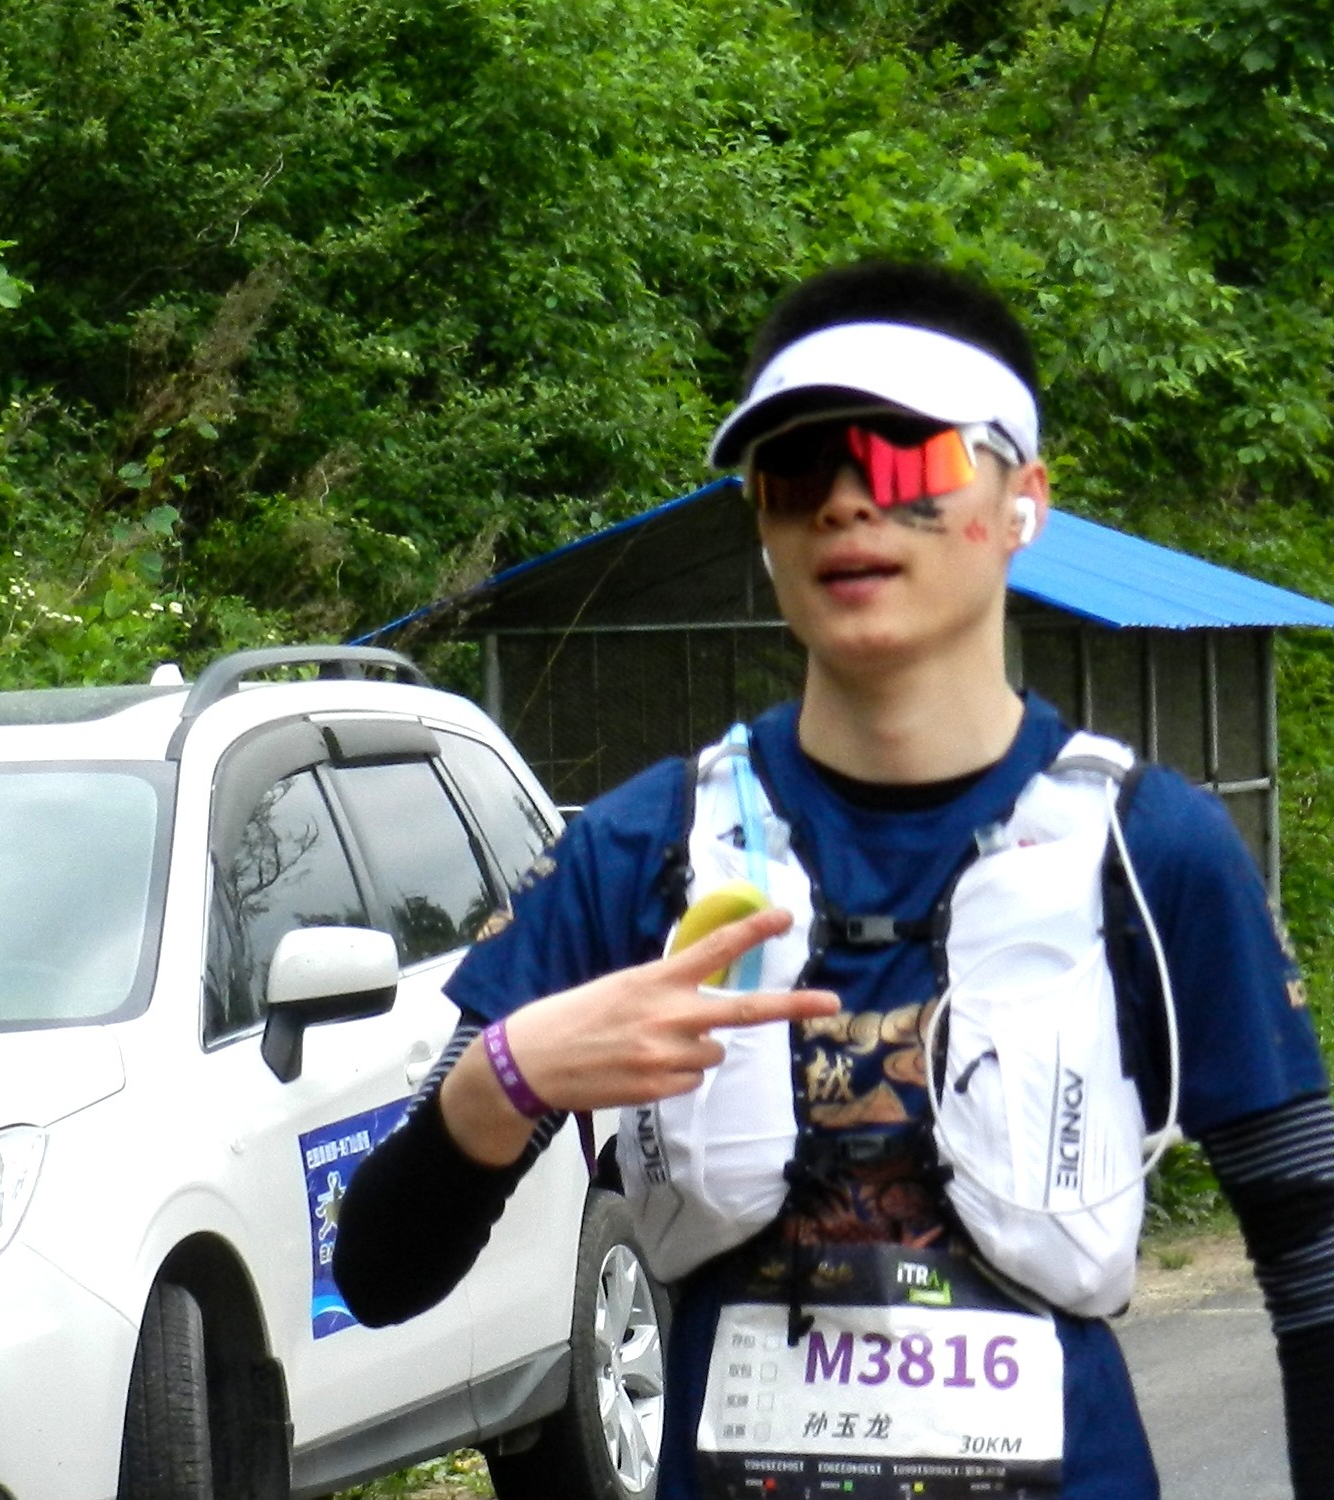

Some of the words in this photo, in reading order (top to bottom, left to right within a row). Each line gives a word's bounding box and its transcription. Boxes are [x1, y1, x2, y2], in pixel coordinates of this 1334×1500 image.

[635, 1109, 667, 1182] NIJIE
[804, 1330, 1020, 1391] M3816
[803, 1411, 892, 1439] 孙玉龙
[958, 1435, 1022, 1454] 30KM
